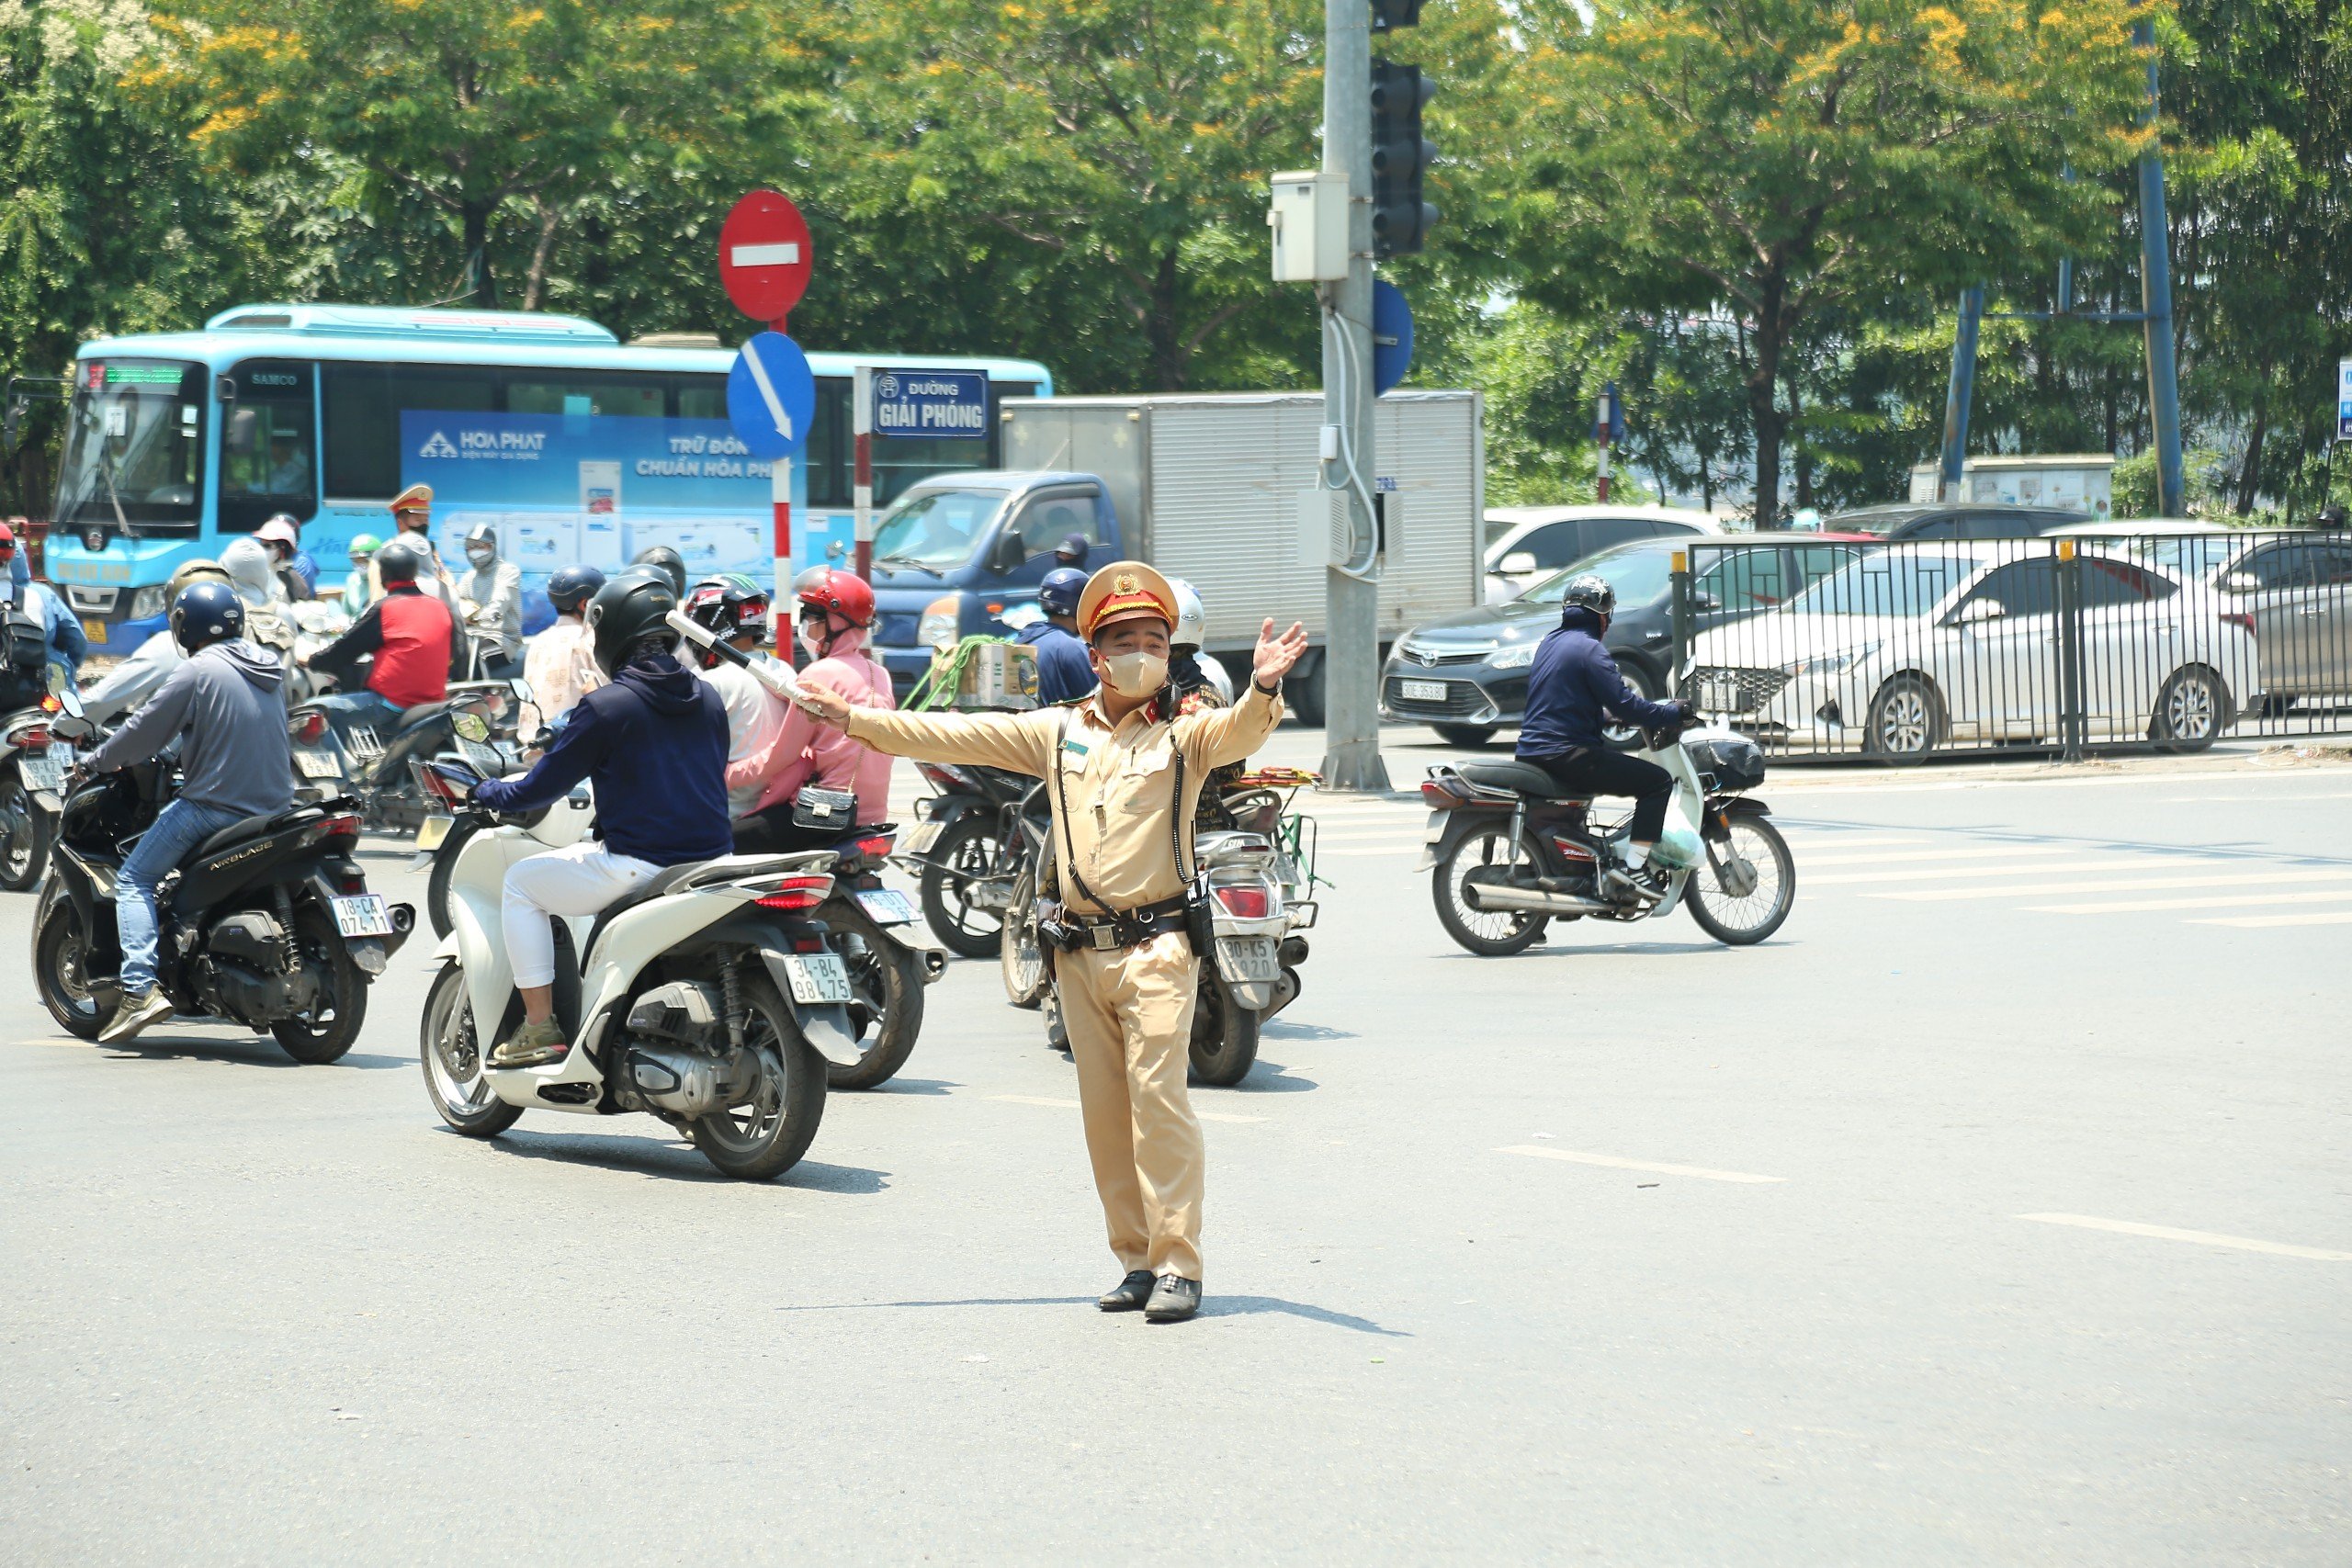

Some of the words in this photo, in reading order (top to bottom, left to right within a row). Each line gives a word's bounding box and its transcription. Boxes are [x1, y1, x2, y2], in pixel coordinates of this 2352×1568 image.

[908, 379, 959, 396] ĐƯỜNG
[879, 396, 917, 428] GIẢI
[922, 400, 983, 429] PHÓNG
[460, 432, 499, 449] HOA
[500, 433, 546, 450] PHAT
[669, 435, 707, 454] TRỮ
[704, 459, 742, 478] HÒA
[341, 897, 378, 916] 18-CA
[341, 915, 389, 933] 074.11
[794, 958, 837, 978] 34-B4
[1238, 960, 1271, 978] 920
[795, 979, 849, 999] 984.75
